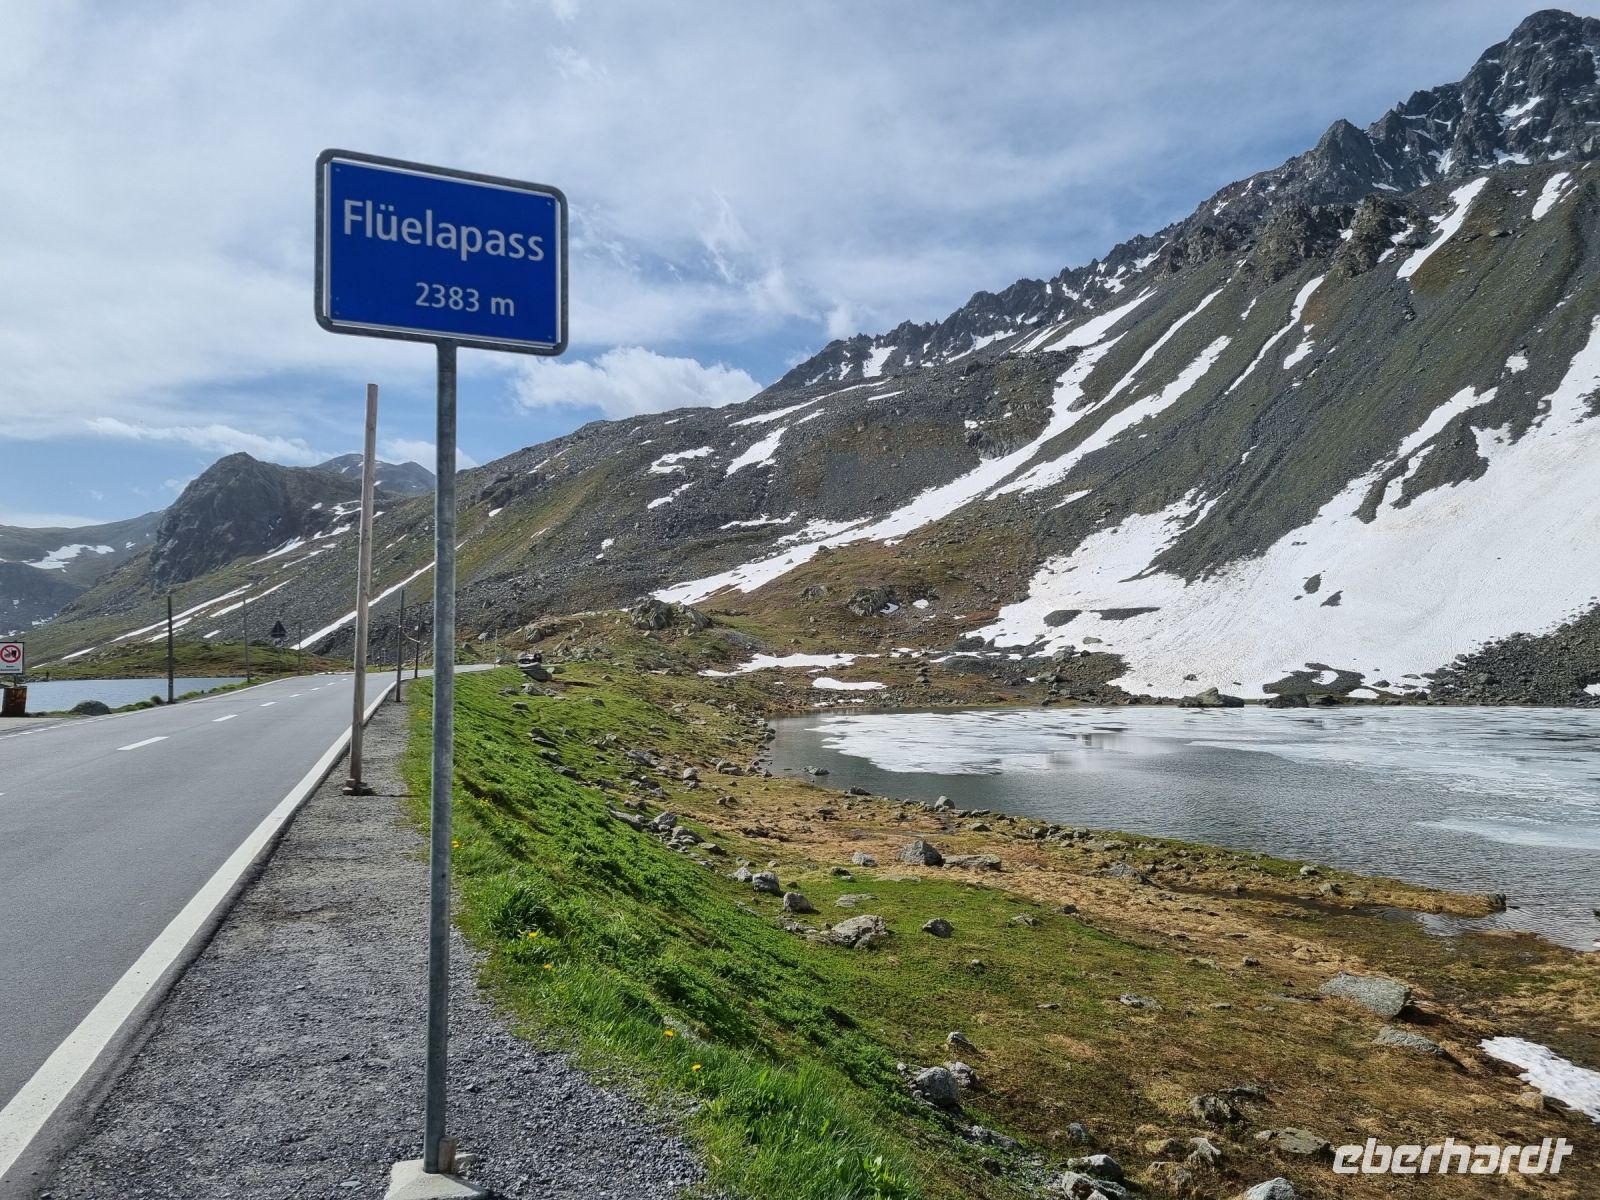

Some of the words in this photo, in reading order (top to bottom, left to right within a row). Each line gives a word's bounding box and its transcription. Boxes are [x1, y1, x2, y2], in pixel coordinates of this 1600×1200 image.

[343, 199, 545, 262] Flüelapass
[415, 281, 480, 312] 2383
[490, 296, 515, 317] m
